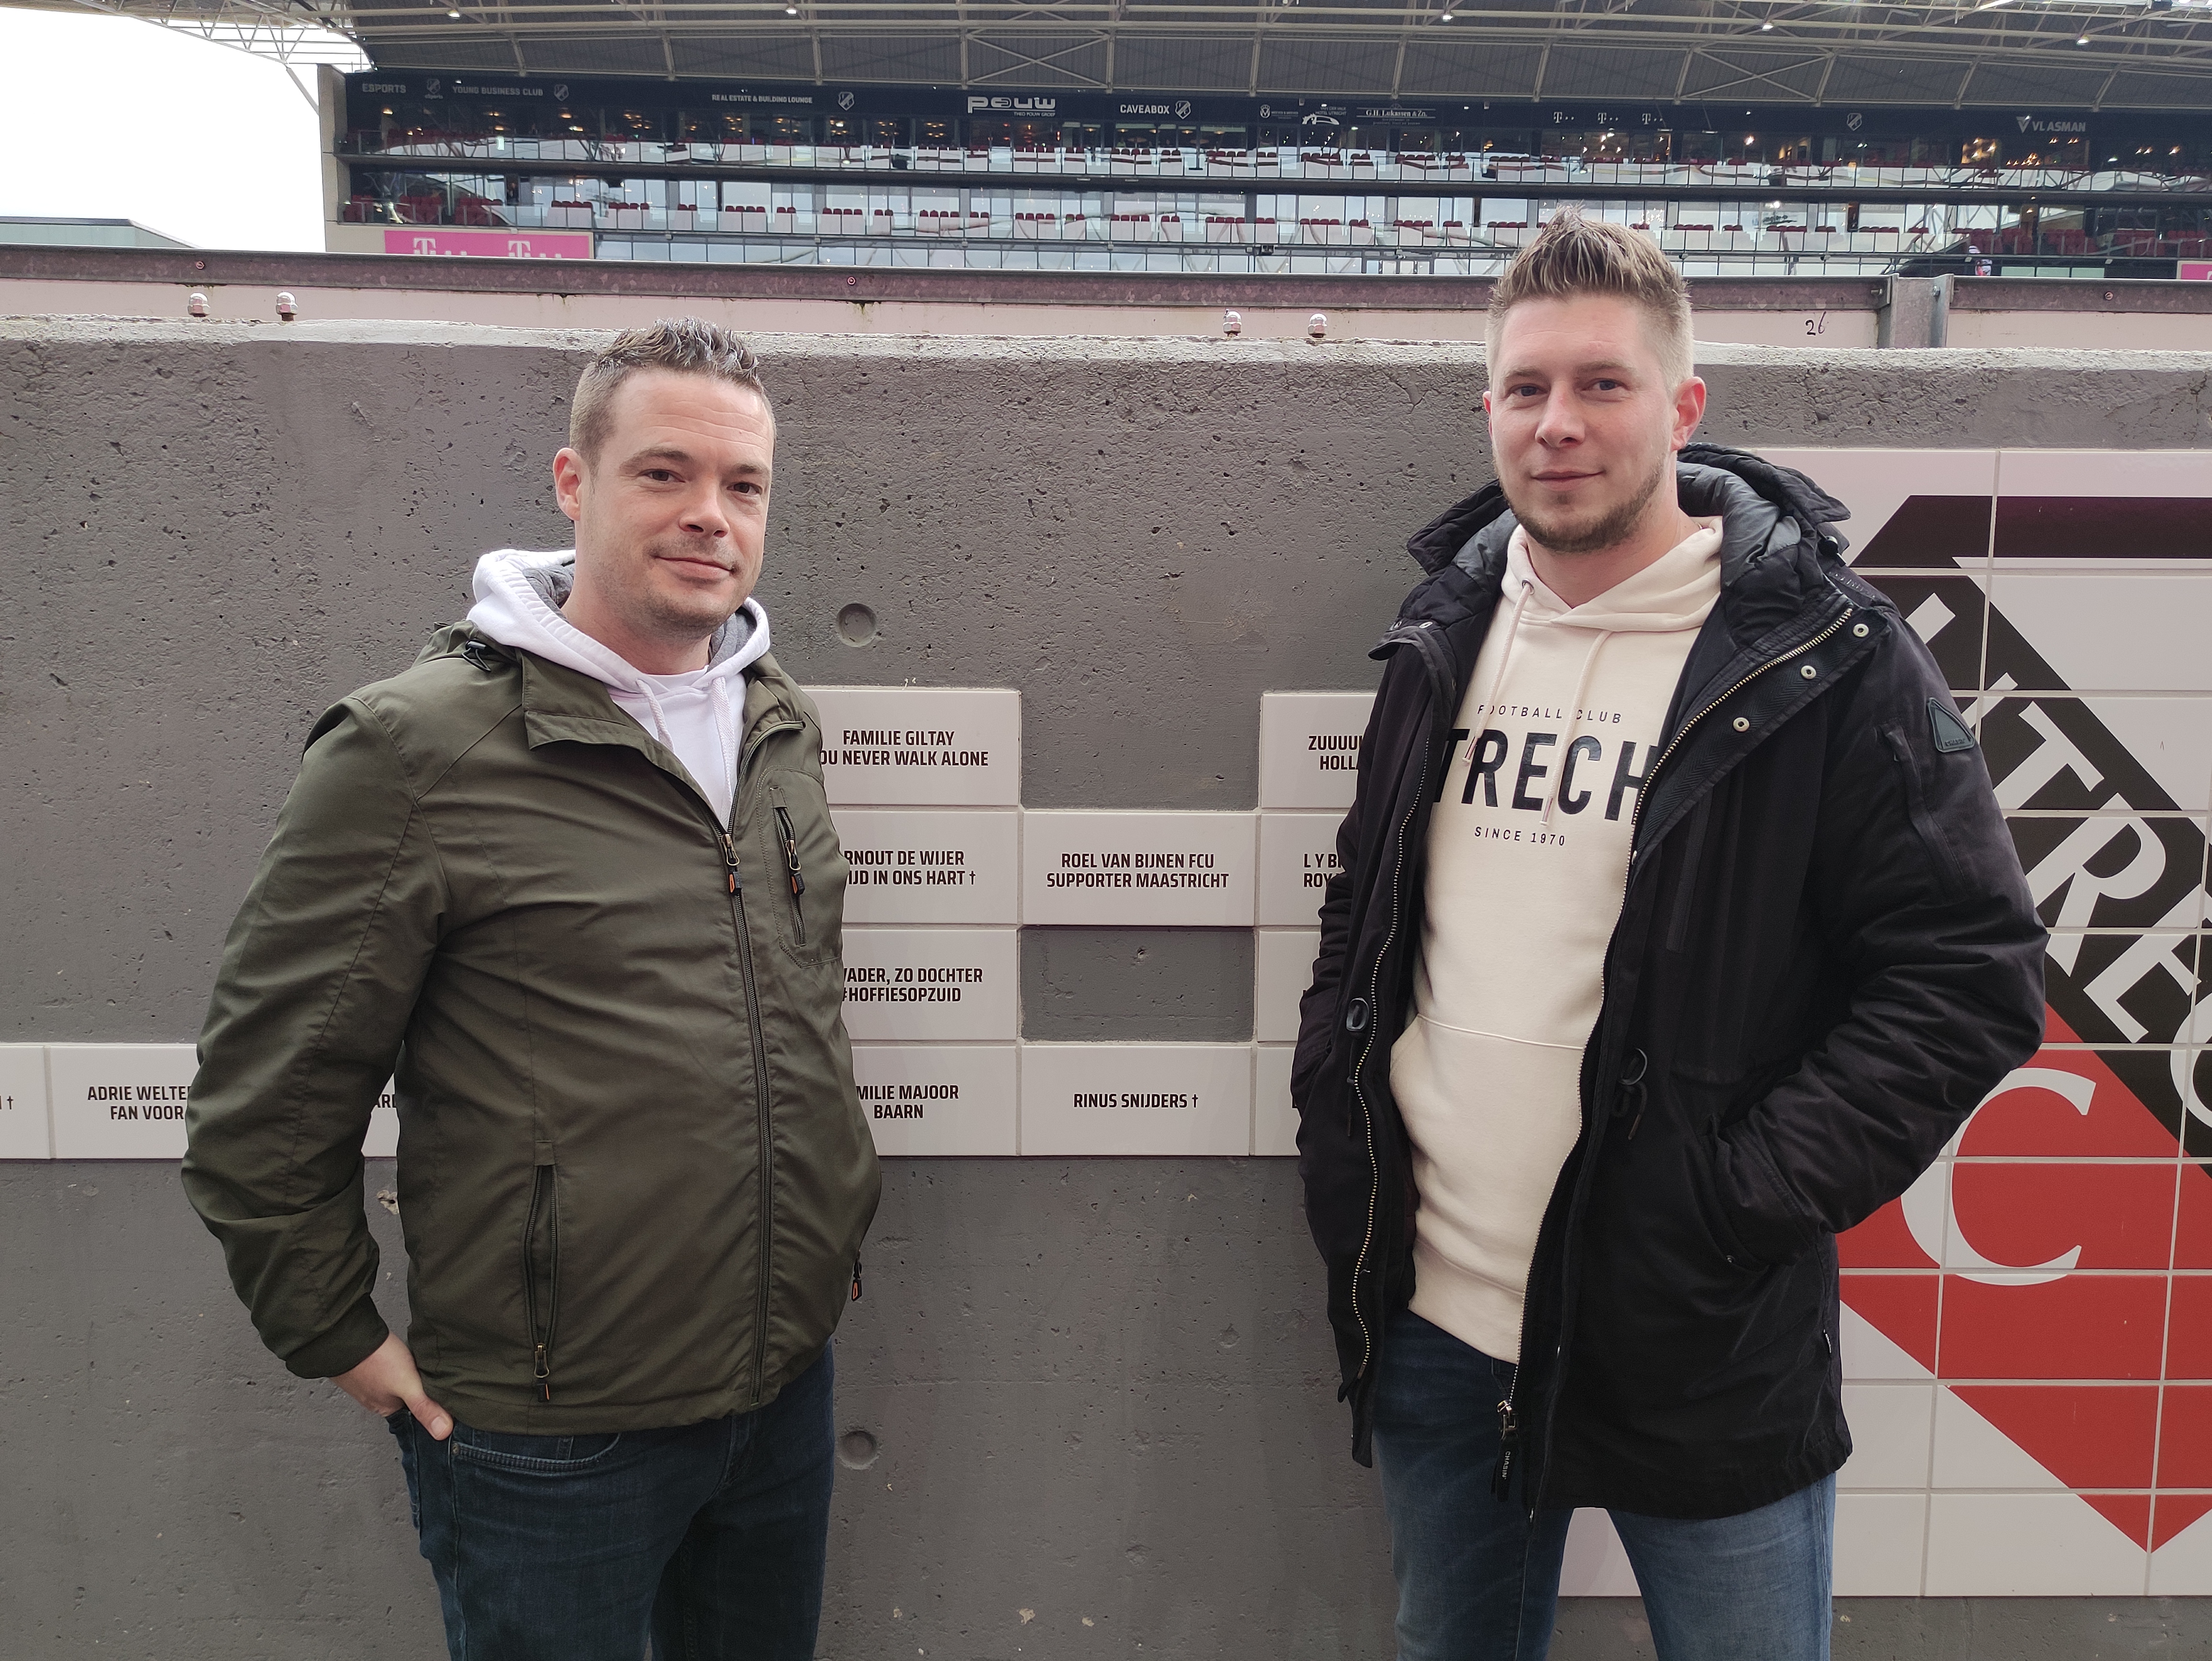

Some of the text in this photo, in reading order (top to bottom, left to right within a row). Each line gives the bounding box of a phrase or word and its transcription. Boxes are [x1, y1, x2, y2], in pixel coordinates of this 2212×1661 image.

[362, 83, 406, 93] ESPORTS
[481, 87, 520, 95] BUSINESS
[1120, 105, 1170, 114] CAVEABOX
[1805, 311, 1828, 335] 26
[843, 730, 955, 746] FAMILIE GILTAY
[820, 750, 988, 766] OU NEVER WALK ALONE
[1320, 755, 1358, 770] HOLL
[1433, 728, 1659, 825] TRECH
[1474, 826, 1566, 846] SINCE 1970
[844, 850, 964, 865] RNOUT DE WIJER
[1062, 853, 1214, 868] ROEL VAN BIJNEN FCU
[849, 870, 869, 885] IJD
[874, 870, 888, 885] IN
[893, 870, 922, 885] ONS
[927, 870, 965, 885] HART
[1047, 873, 1229, 888] SUPPORTER MAASTRICHT
[895, 968, 913, 983] ZO
[918, 968, 983, 983] DOCHTER
[88, 1086, 191, 1100] ADRIE WELTE
[856, 1085, 959, 1100] MILIE MAJOOR
[1074, 1094, 1117, 1107] RINUS
[1121, 1094, 1187, 1108] SNIJDERS
[111, 1106, 185, 1120] FAN VOOR
[874, 1104, 923, 1119] BAARN
